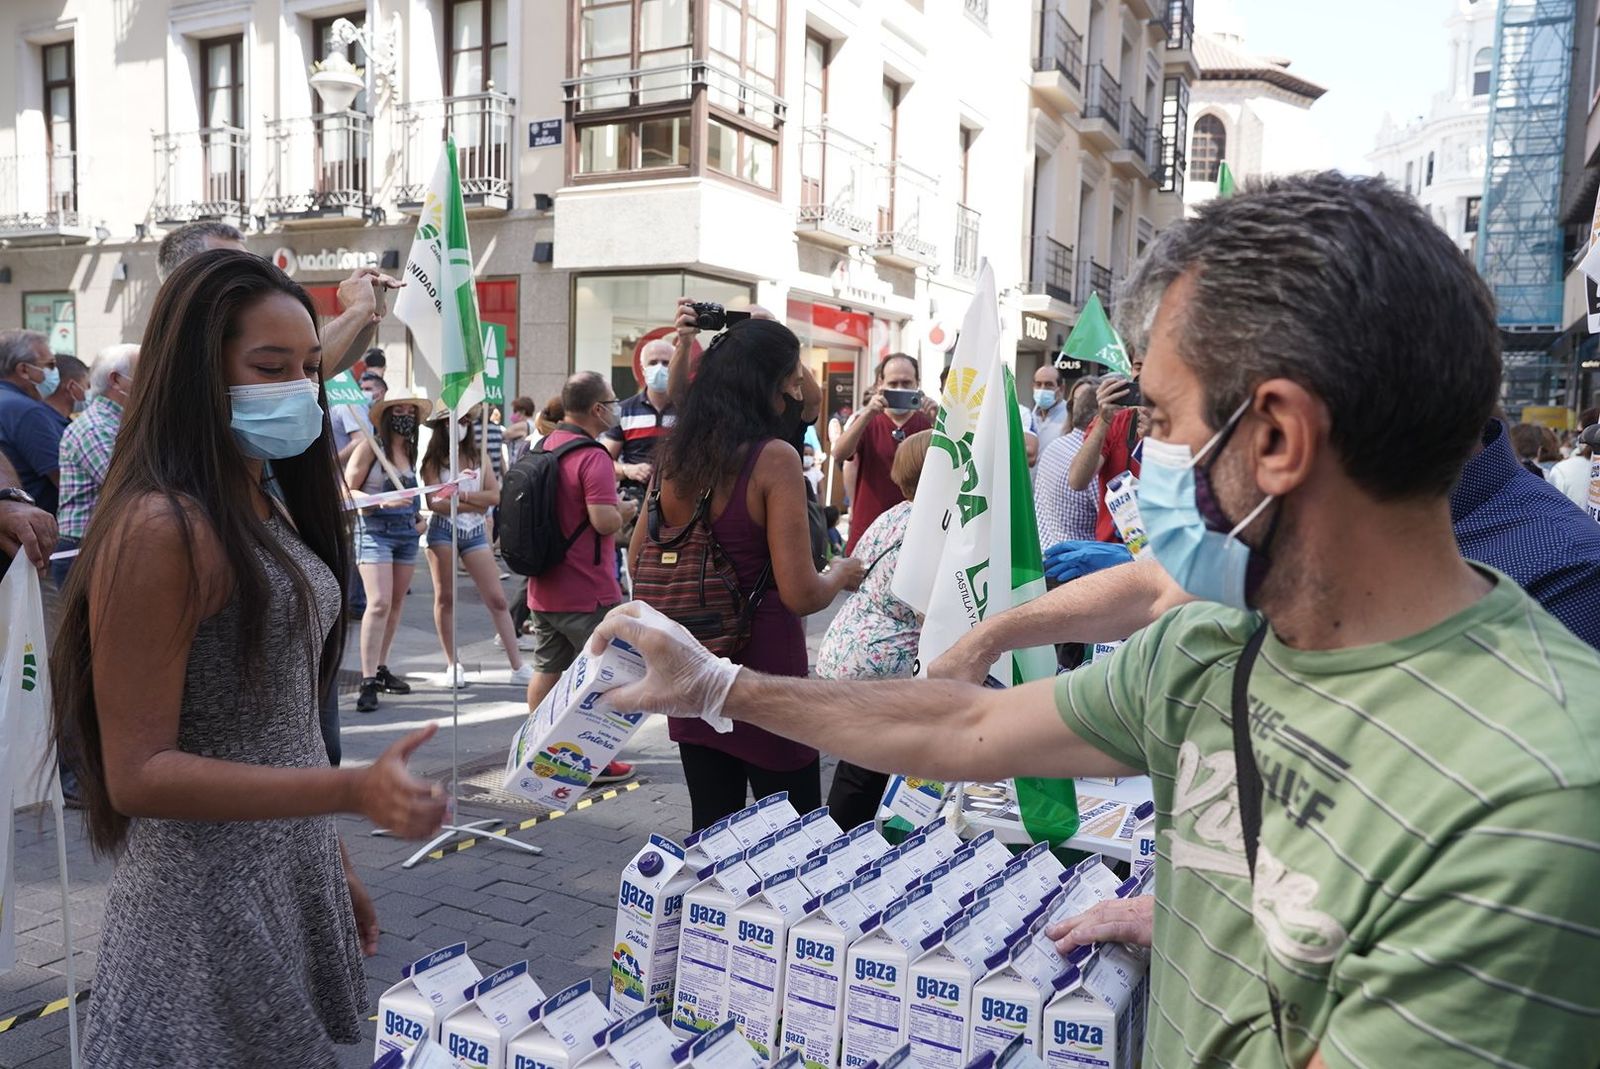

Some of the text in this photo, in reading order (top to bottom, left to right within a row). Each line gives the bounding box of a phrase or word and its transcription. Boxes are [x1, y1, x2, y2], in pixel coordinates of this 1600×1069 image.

[297, 247, 378, 270] vodafone
[1025, 317, 1048, 341] TOUS
[484, 385, 503, 400] AJA
[1109, 492, 1132, 514] gaza
[955, 570, 972, 612] CASTILLA
[579, 691, 643, 726] ga
[577, 730, 616, 751] Entera
[1140, 838, 1156, 856] ga
[620, 879, 654, 914] gaza
[664, 894, 684, 916] ga
[690, 903, 726, 928] gaza
[626, 929, 648, 950] Entera
[738, 920, 774, 945] gaza
[796, 937, 835, 962] gaza
[855, 958, 897, 982] gaza
[651, 981, 669, 995] gaza
[678, 991, 698, 1004] gaza
[916, 976, 960, 1002] gaza
[982, 996, 1028, 1024] gaza
[385, 1010, 423, 1041] gaza
[1054, 1020, 1104, 1045] gaza
[449, 1032, 490, 1065] gaza
[785, 1031, 806, 1045] gaza
